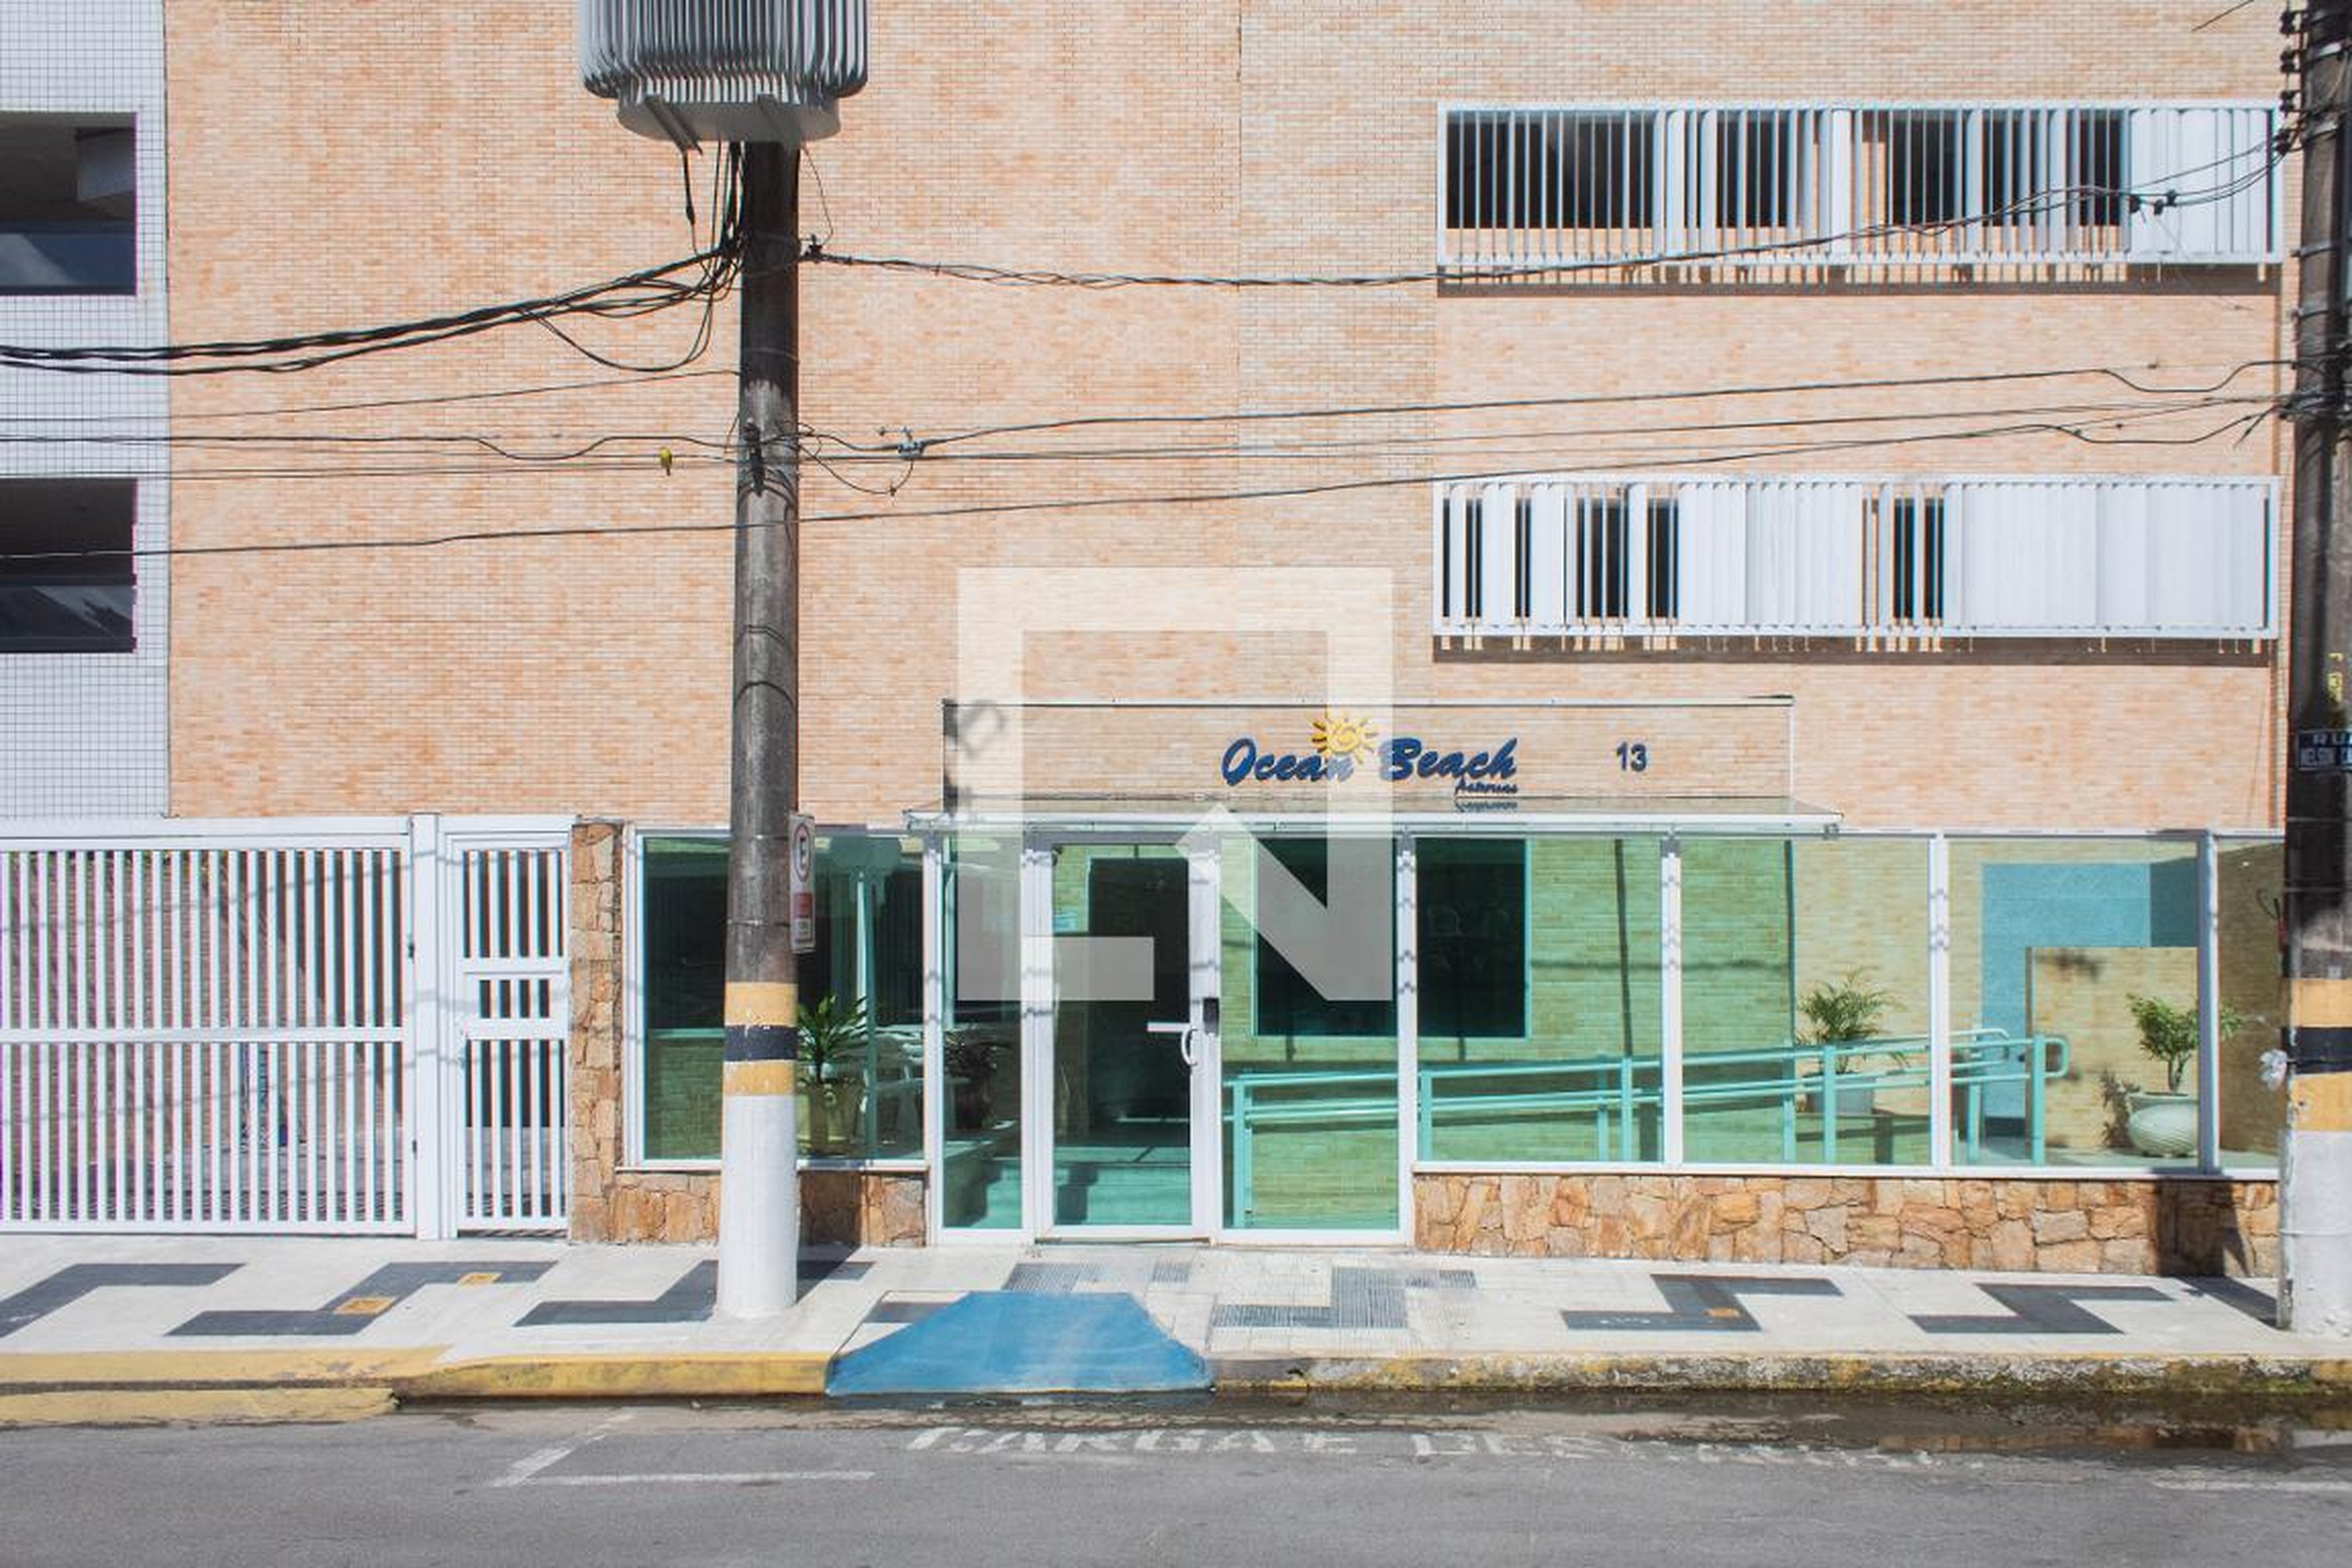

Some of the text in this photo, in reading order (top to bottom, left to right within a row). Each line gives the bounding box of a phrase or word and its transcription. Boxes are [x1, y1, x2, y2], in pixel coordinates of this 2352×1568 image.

[1221, 737, 1518, 786] Ocean Beach
[1616, 741, 1647, 772] 13
[907, 1427, 1275, 1453] CARGA
